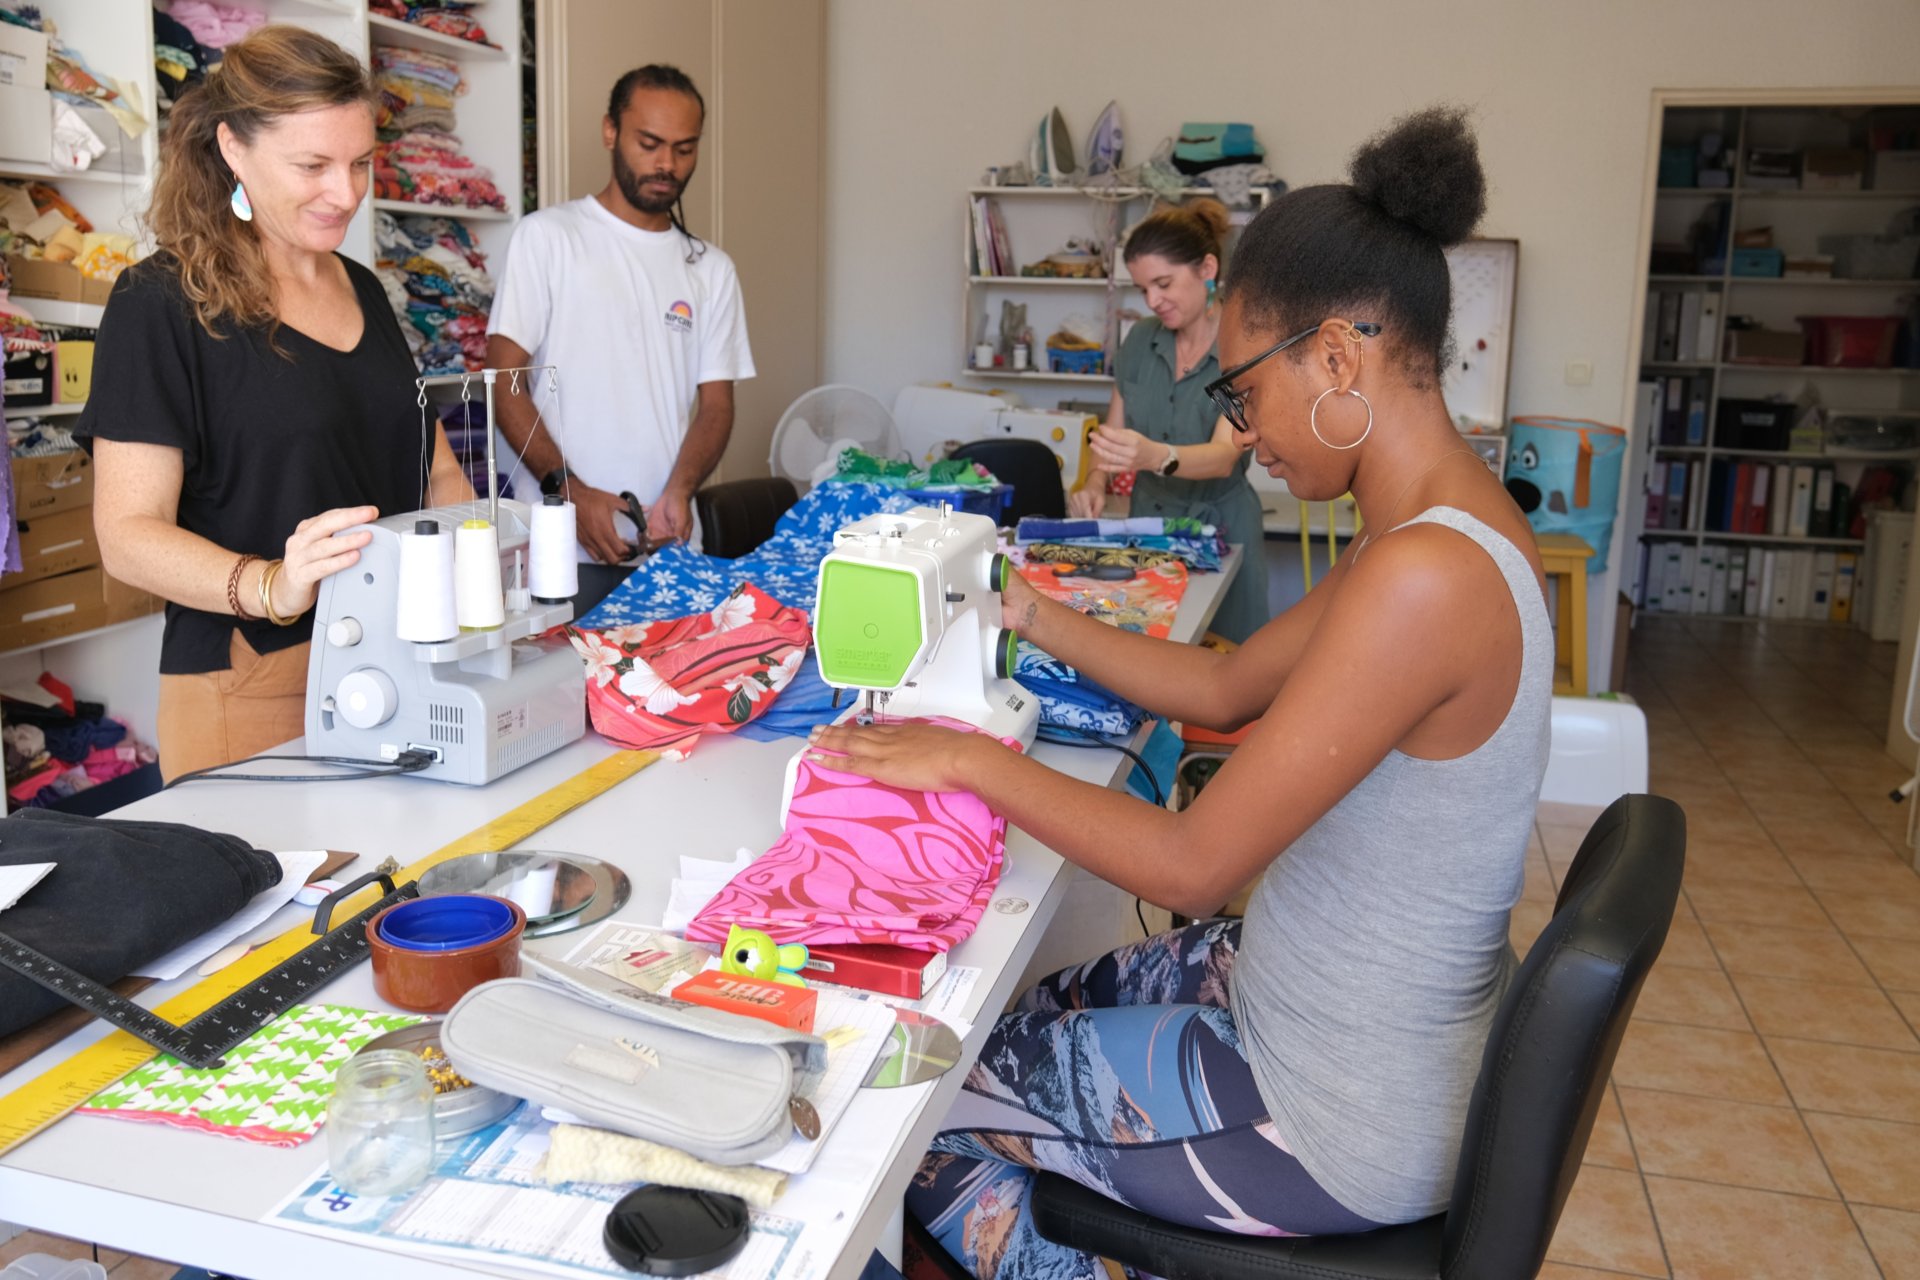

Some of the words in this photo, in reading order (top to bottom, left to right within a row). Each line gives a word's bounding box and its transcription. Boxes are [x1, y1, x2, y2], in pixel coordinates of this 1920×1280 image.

[665, 312, 677, 321] RIP
[258, 986, 269, 994] 3
[714, 978, 785, 1001] JBL
[235, 1001, 246, 1009] 2
[251, 1010, 262, 1018] 3
[227, 1025, 238, 1034] 2
